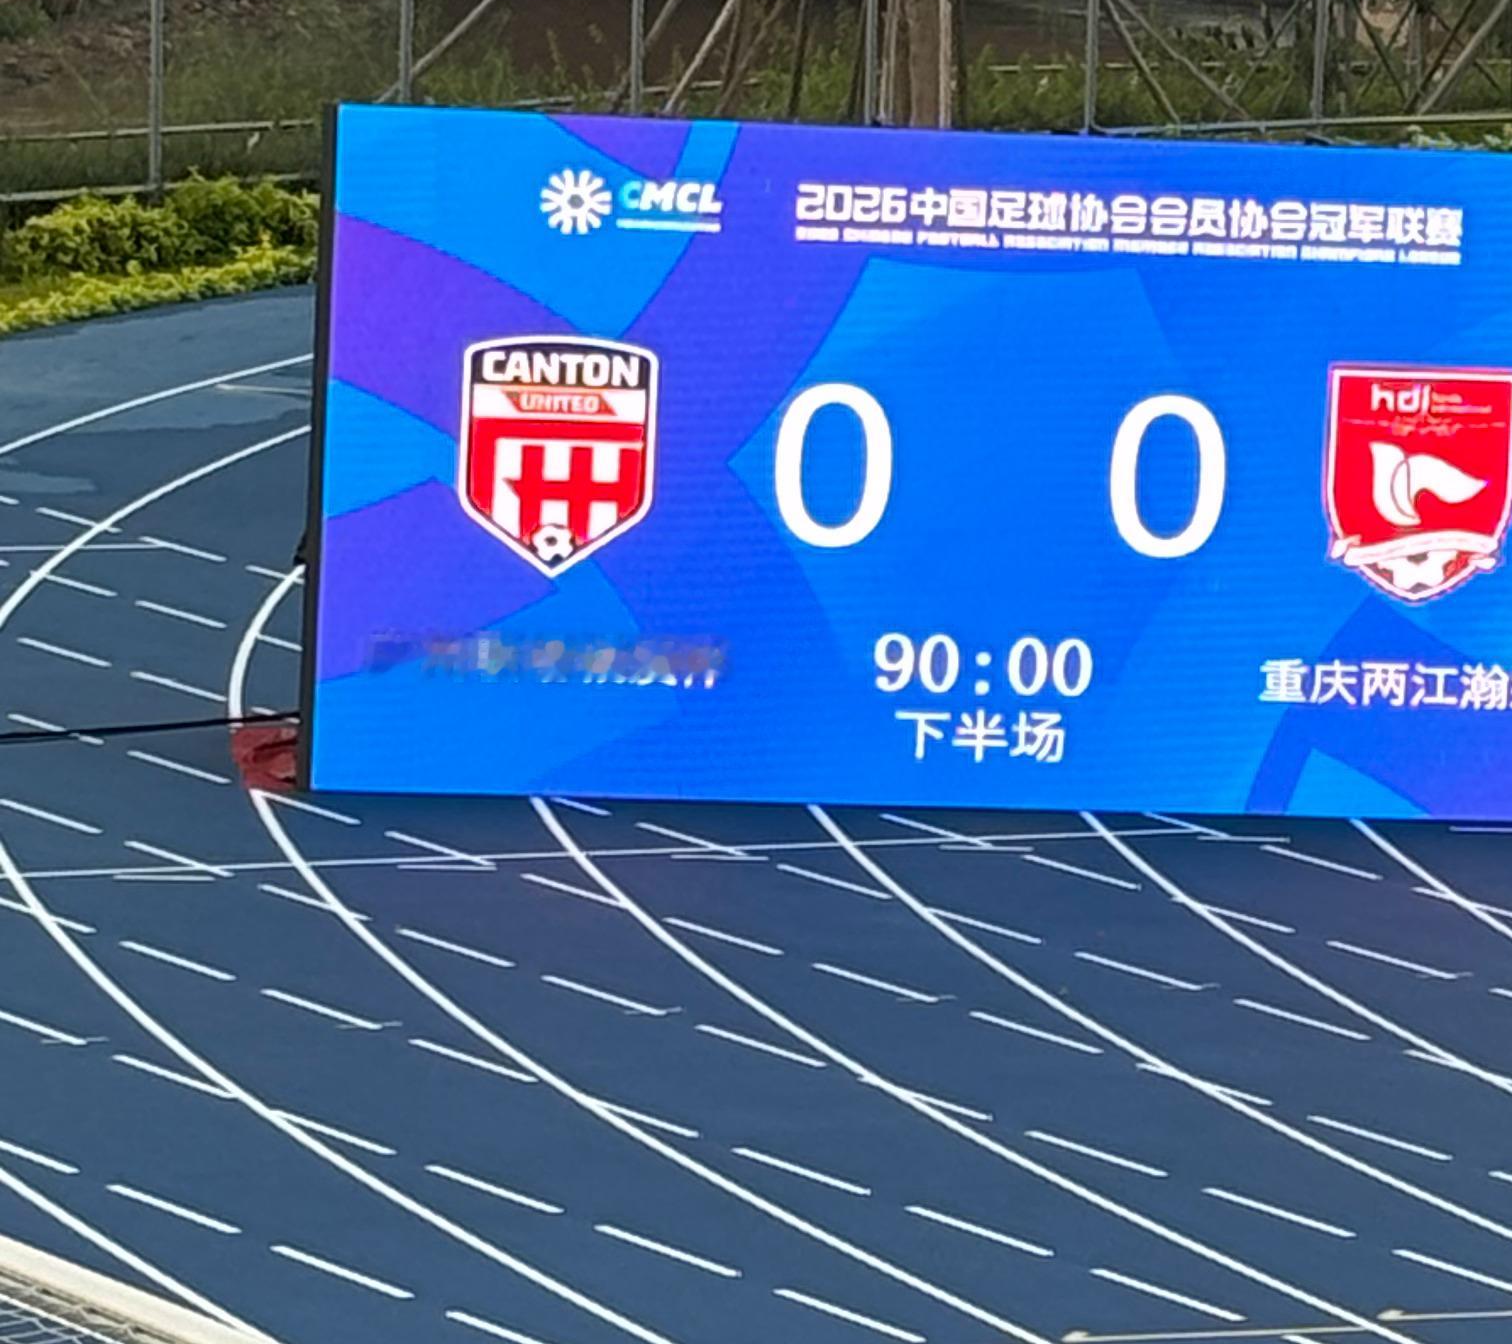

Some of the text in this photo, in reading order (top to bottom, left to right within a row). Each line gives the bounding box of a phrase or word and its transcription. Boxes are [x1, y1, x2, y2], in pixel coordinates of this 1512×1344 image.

[618, 181, 722, 214] CMCL
[796, 183, 1463, 247] 2026中国足球协会会员协会冠军联赛
[482, 351, 639, 388] CANTON
[519, 390, 600, 414] UNITED
[774, 383, 893, 548] 0
[1110, 394, 1227, 558] 0
[874, 632, 1093, 697] 90:00
[894, 709, 1065, 763] 下半场
